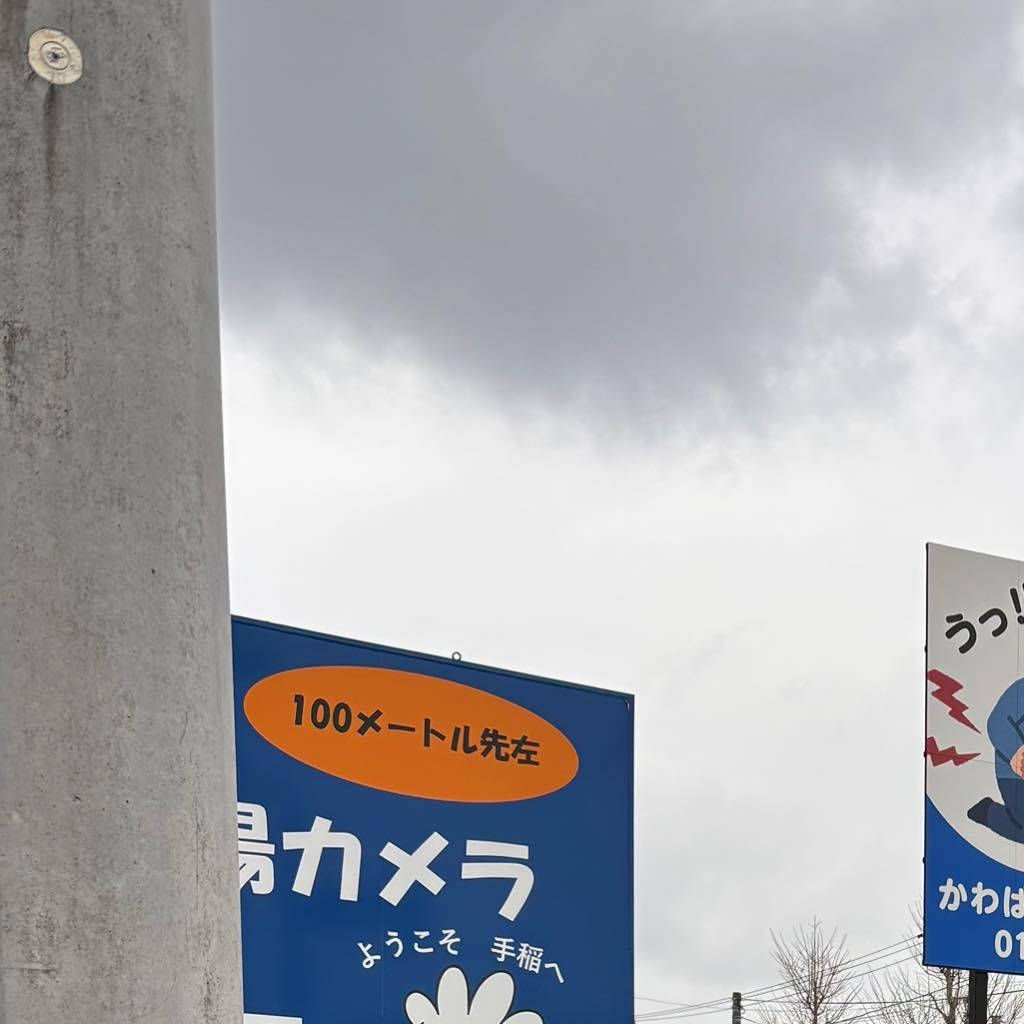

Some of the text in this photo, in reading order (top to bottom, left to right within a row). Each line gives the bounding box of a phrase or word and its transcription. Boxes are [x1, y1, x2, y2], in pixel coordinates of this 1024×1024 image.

[293, 694, 541, 767] 100メートル先左
[357, 928, 565, 983] ようこそ 手稲へ
